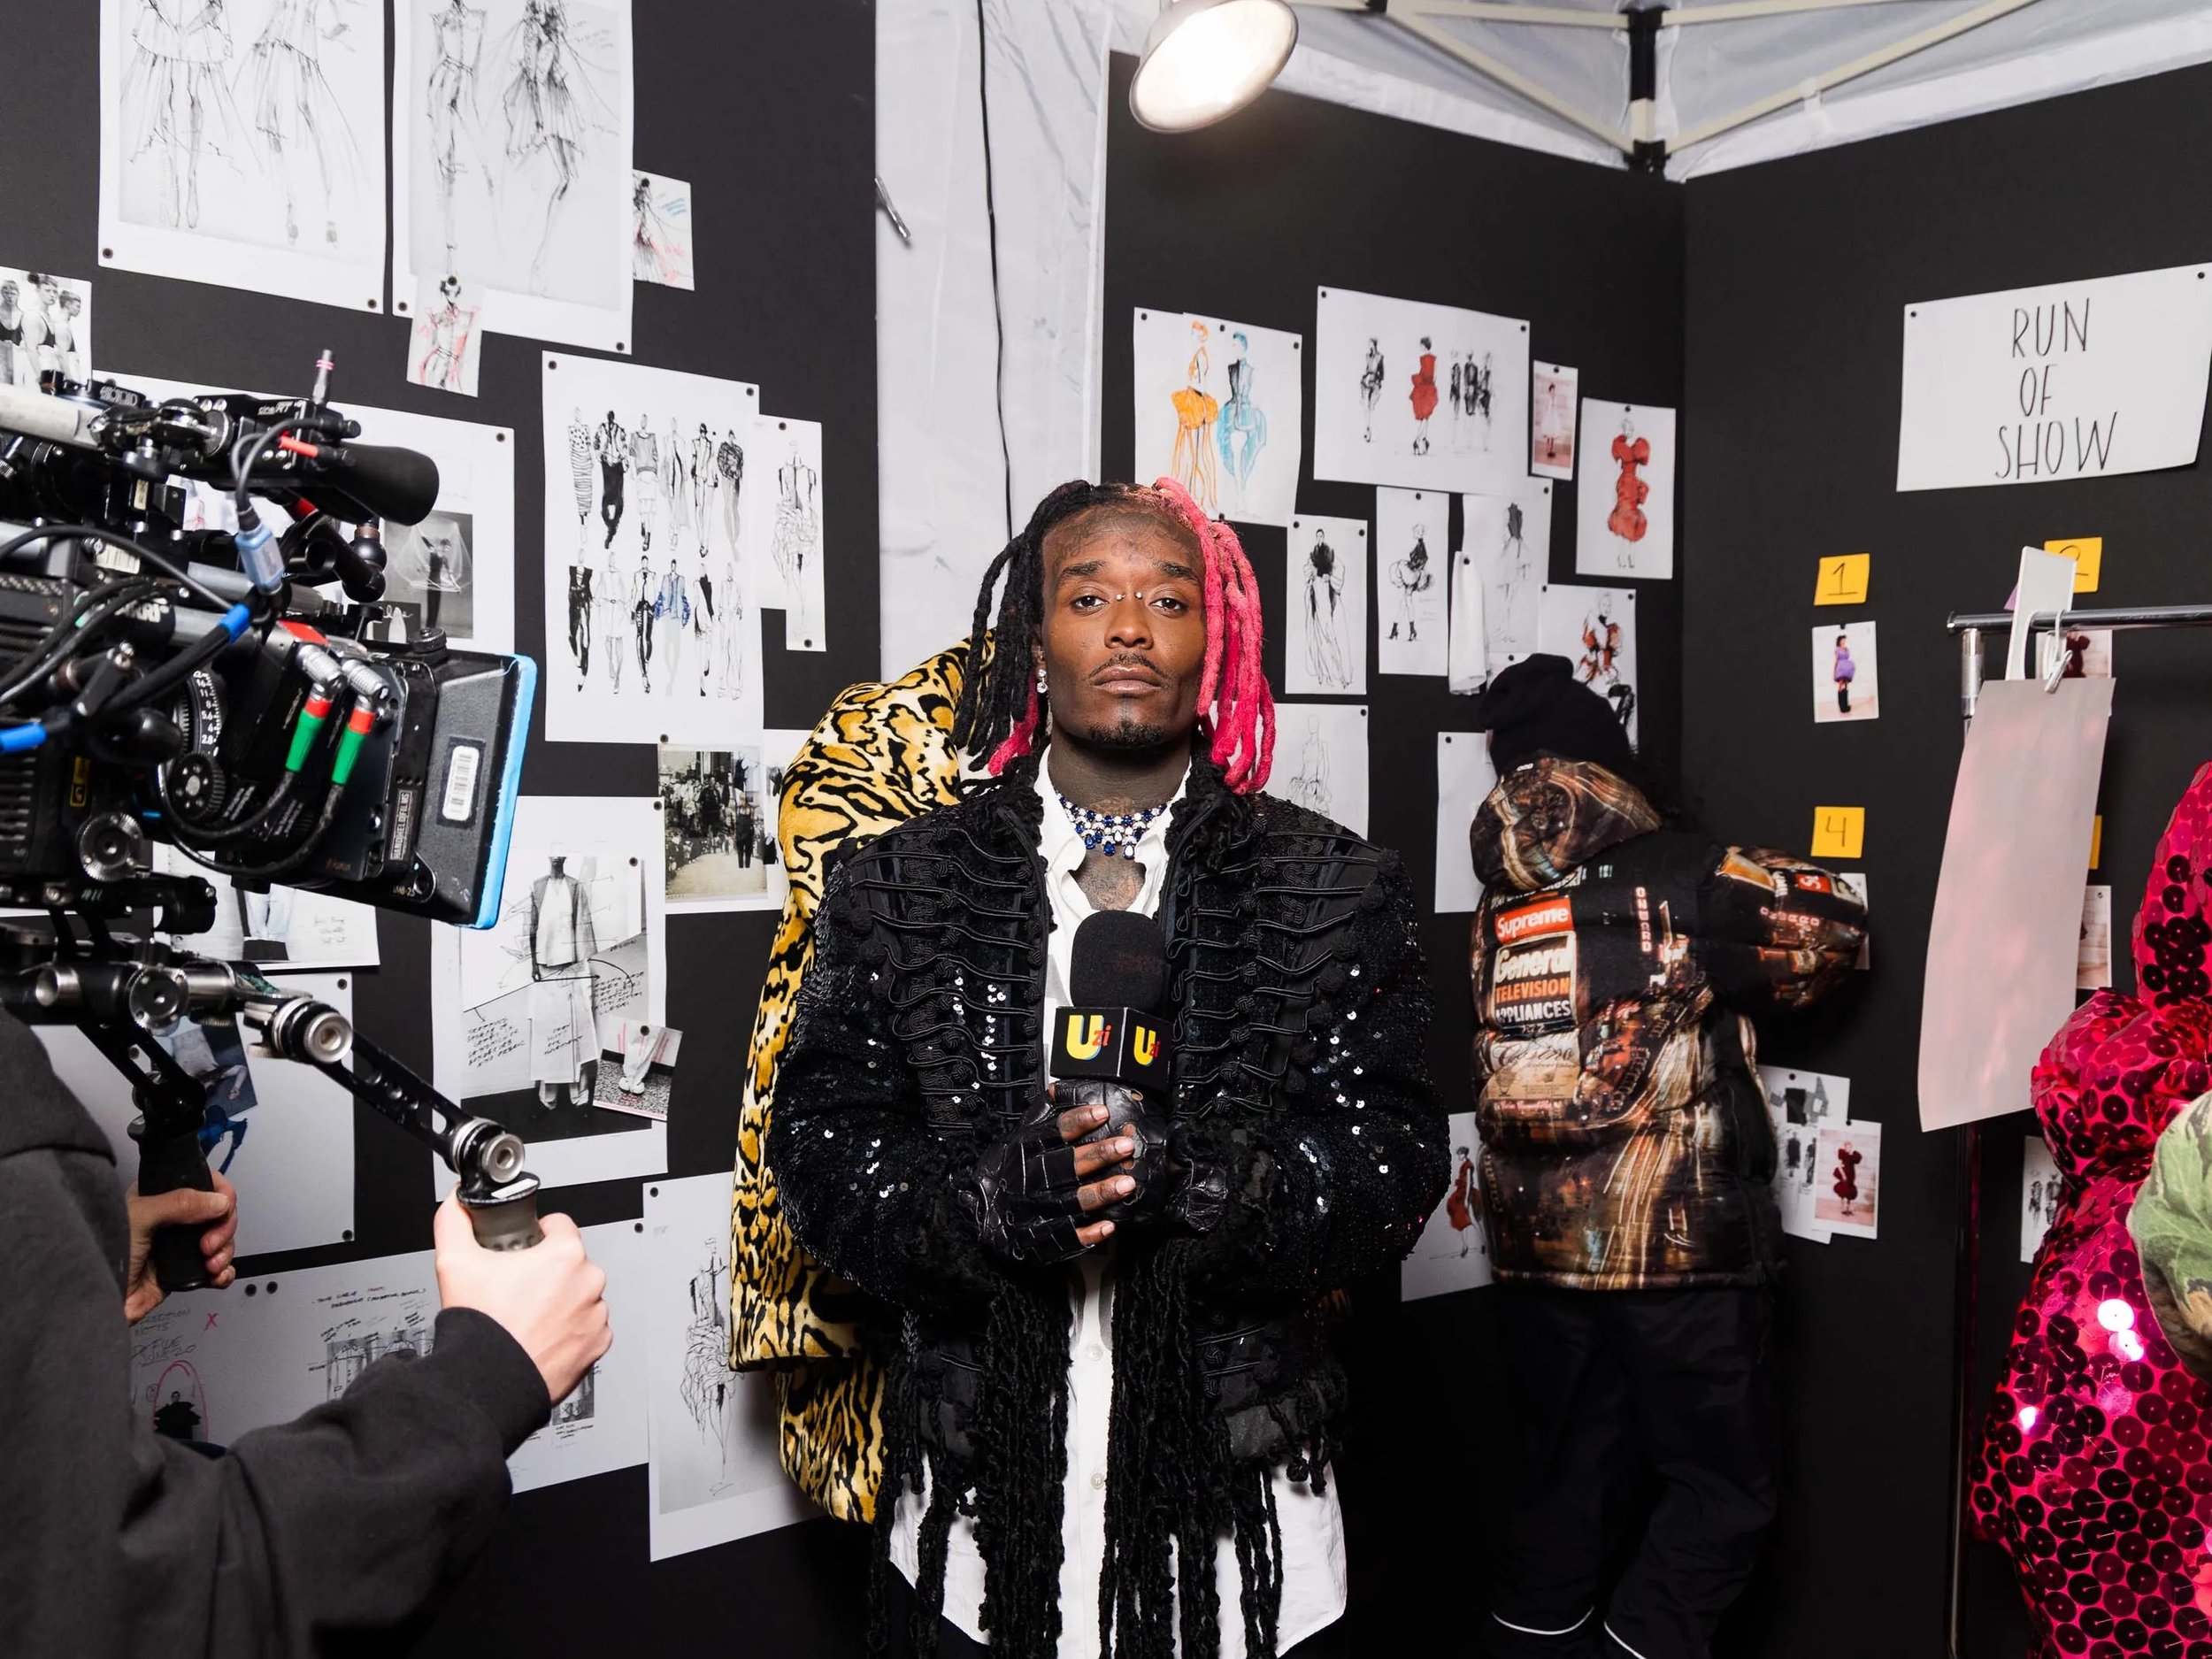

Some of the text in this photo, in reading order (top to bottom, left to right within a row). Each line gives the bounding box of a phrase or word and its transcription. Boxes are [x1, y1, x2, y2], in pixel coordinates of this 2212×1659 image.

[2012, 297, 2090, 358] RUN
[2019, 364, 2058, 417] OF
[1994, 411, 2118, 480] SHOW
[1826, 562, 1859, 596] 1
[1824, 815, 1849, 848] 4
[1497, 907, 1569, 940] Supreme
[1495, 935, 1574, 983] General
[1495, 977, 1571, 1002] TELEVISION
[1495, 1000, 1571, 1024] APPLIANCES
[1066, 1014, 1112, 1061] Uzi
[1133, 1025, 1161, 1068] Uzi
